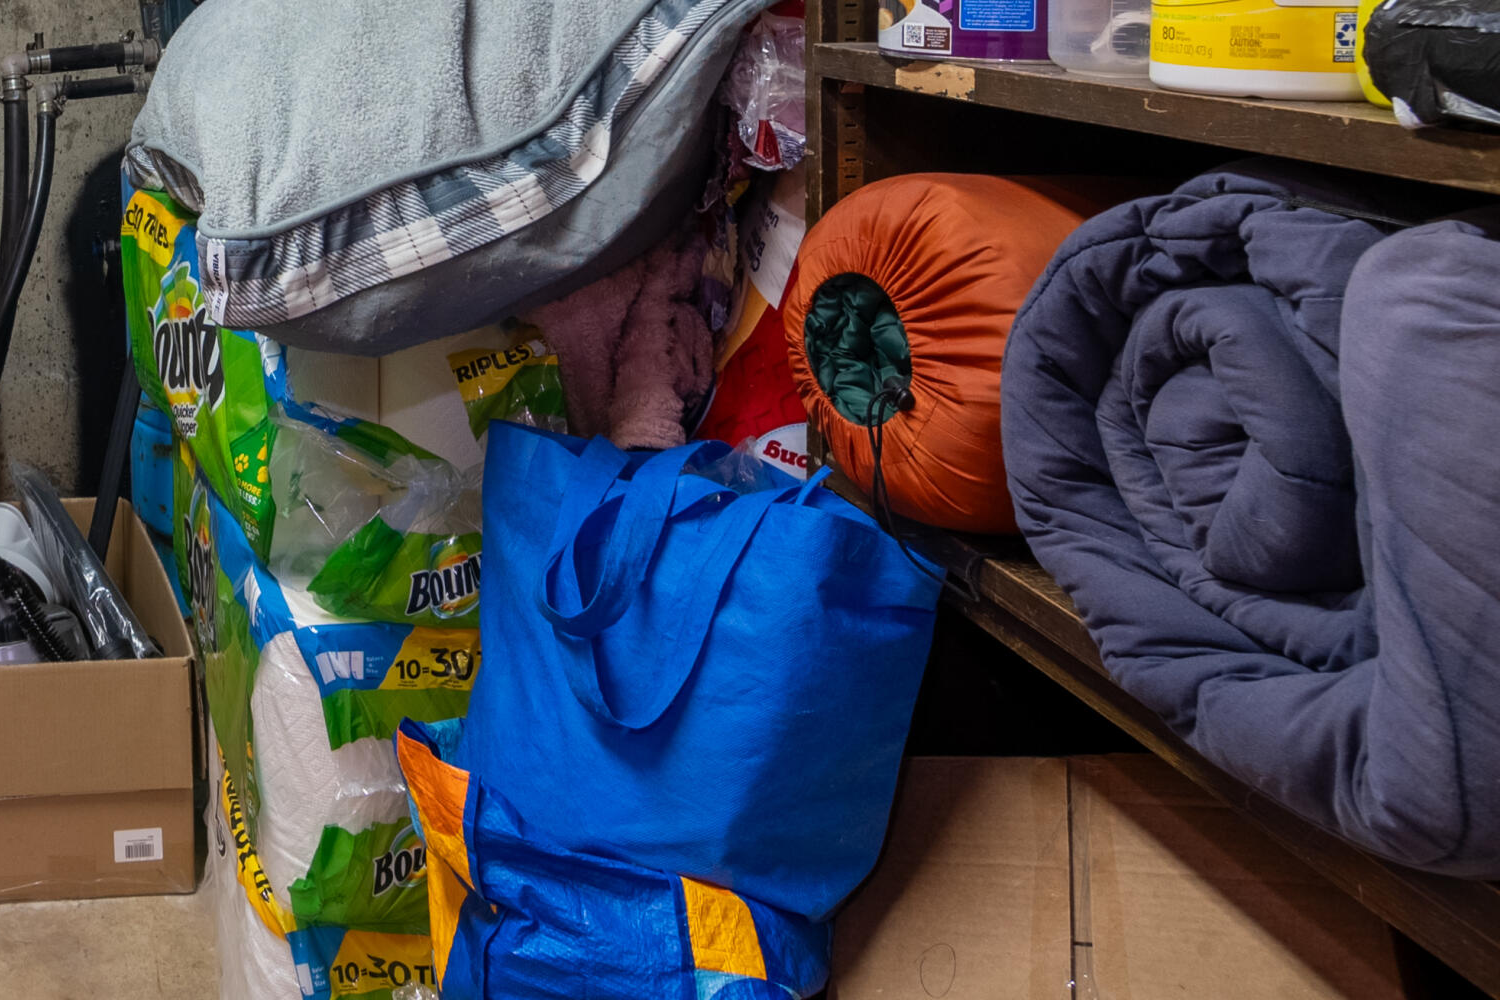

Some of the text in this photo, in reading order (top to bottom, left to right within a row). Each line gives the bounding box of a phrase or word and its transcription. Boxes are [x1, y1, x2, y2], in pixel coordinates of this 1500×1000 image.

[1162, 26, 1176, 40] 80
[212, 253, 225, 293] VIBRANT
[148, 304, 226, 414] ounty
[453, 344, 530, 383] RIPLES
[174, 405, 196, 419] Quicker
[241, 481, 262, 498] MORE
